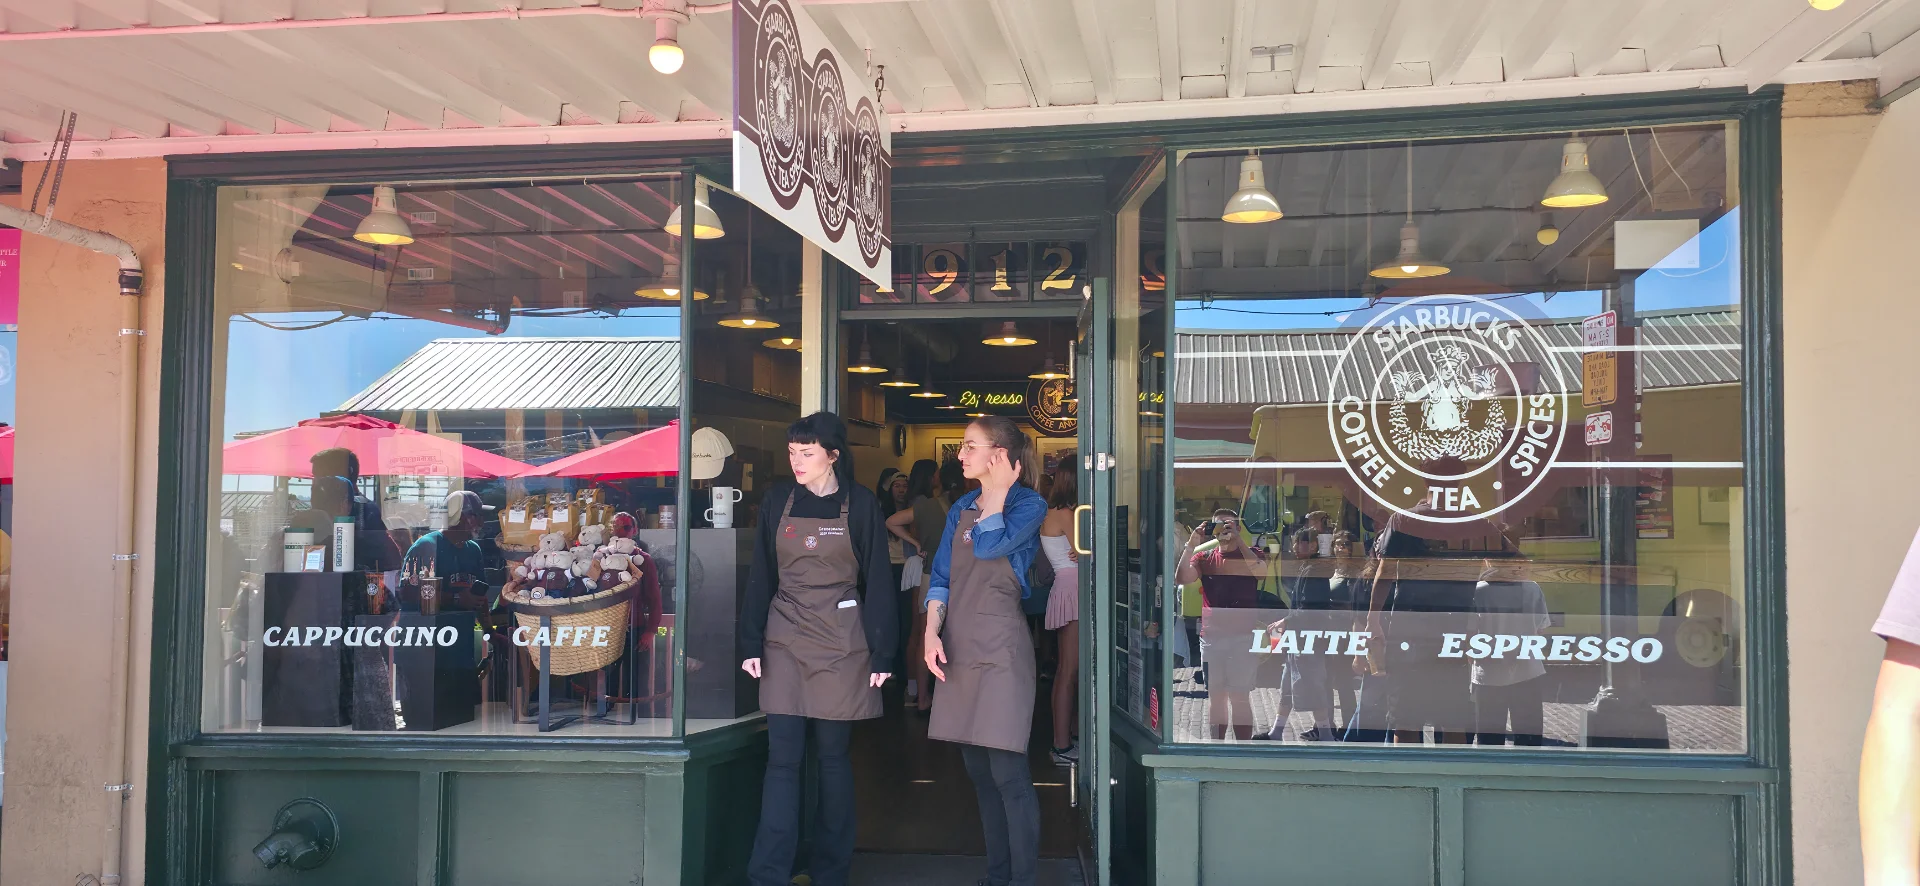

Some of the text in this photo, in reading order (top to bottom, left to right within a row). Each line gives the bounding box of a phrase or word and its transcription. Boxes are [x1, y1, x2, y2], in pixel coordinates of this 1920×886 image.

[765, 12, 797, 67] STARBUCKS
[759, 98, 777, 177] COFFEE
[778, 165, 790, 189] TEA
[828, 204, 838, 225] TEA
[875, 247, 1076, 295] 912
[1373, 305, 1521, 352] STARBUCKS
[1030, 405, 1055, 428] COFFEE
[1338, 392, 1555, 512] COFFEE TEA SPICES
[263, 626, 611, 647] CAPPUCCINO CAFFE
[1248, 629, 1664, 664] LATTE ESPRESSO
